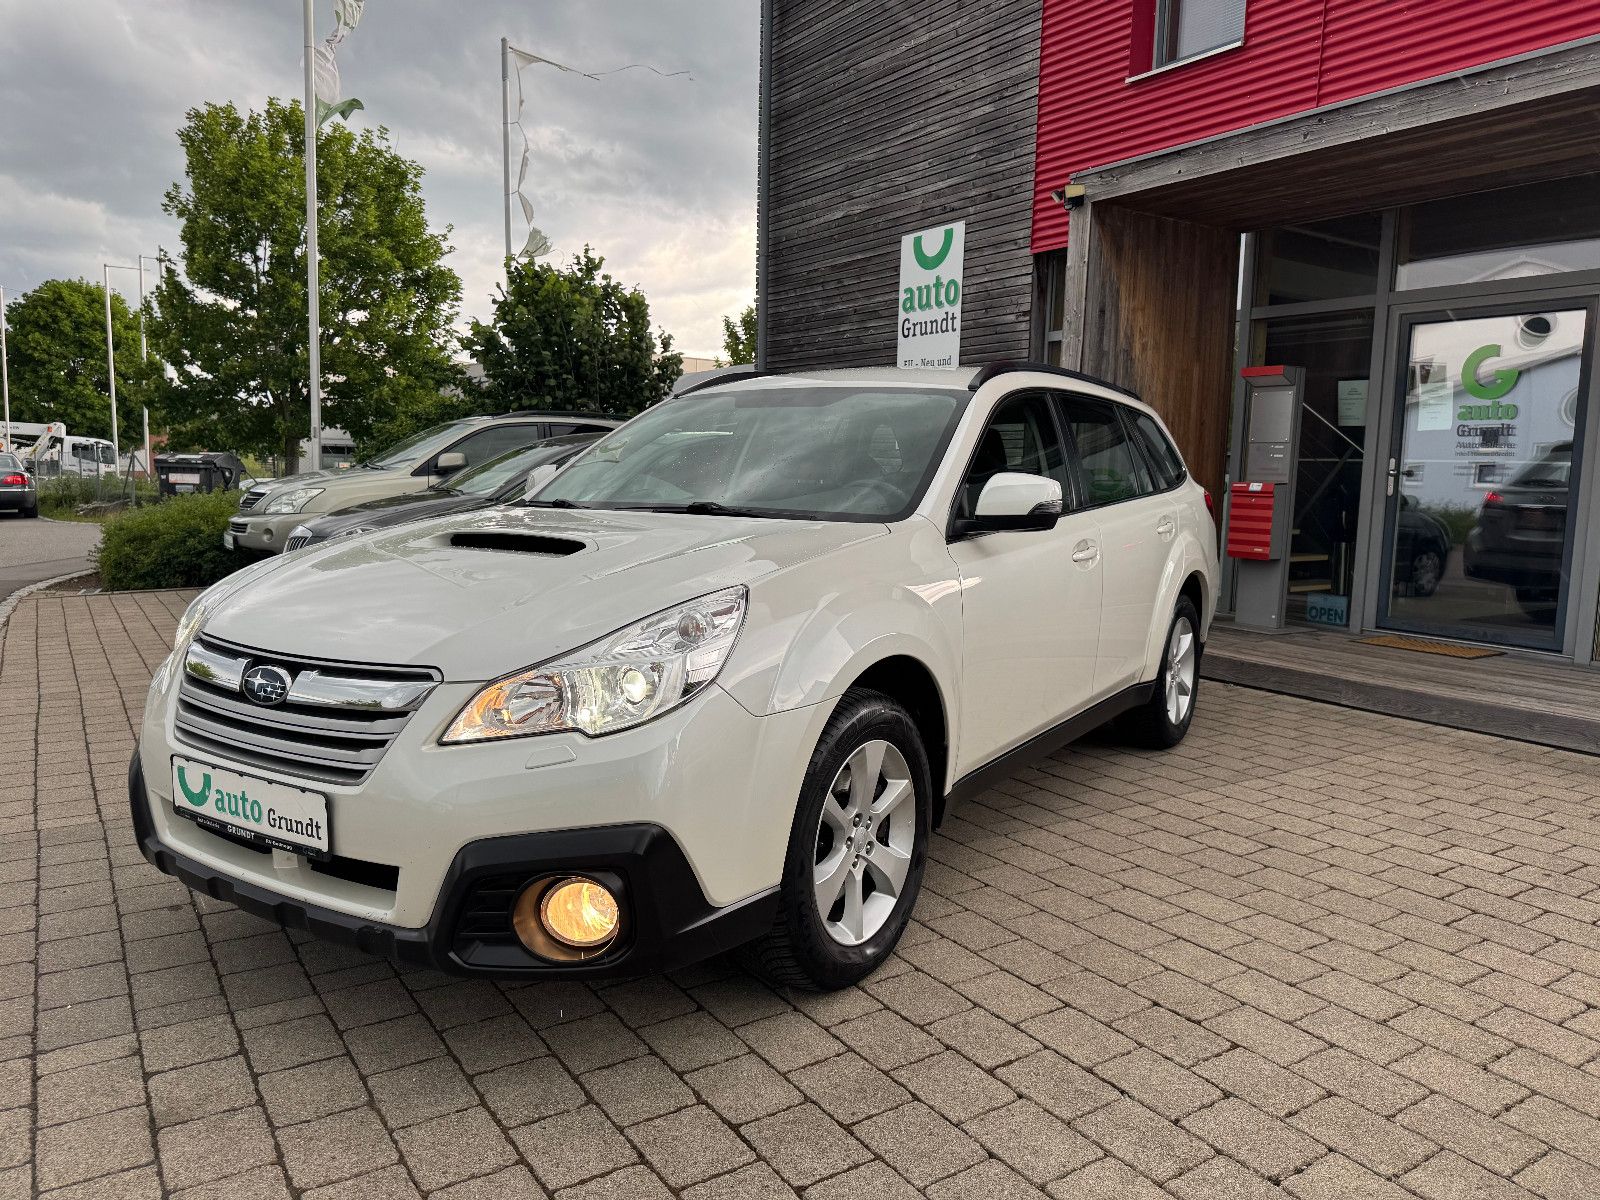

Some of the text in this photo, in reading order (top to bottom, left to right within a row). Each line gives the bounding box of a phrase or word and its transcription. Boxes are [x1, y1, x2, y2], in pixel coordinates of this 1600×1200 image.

[902, 275, 960, 314] auto
[902, 312, 957, 339] Grundt
[937, 355, 952, 367] und
[1456, 400, 1518, 421] auto
[1308, 606, 1344, 623] OPEN
[214, 788, 322, 840] auto Grundt
[227, 825, 255, 840] GRUNDT
